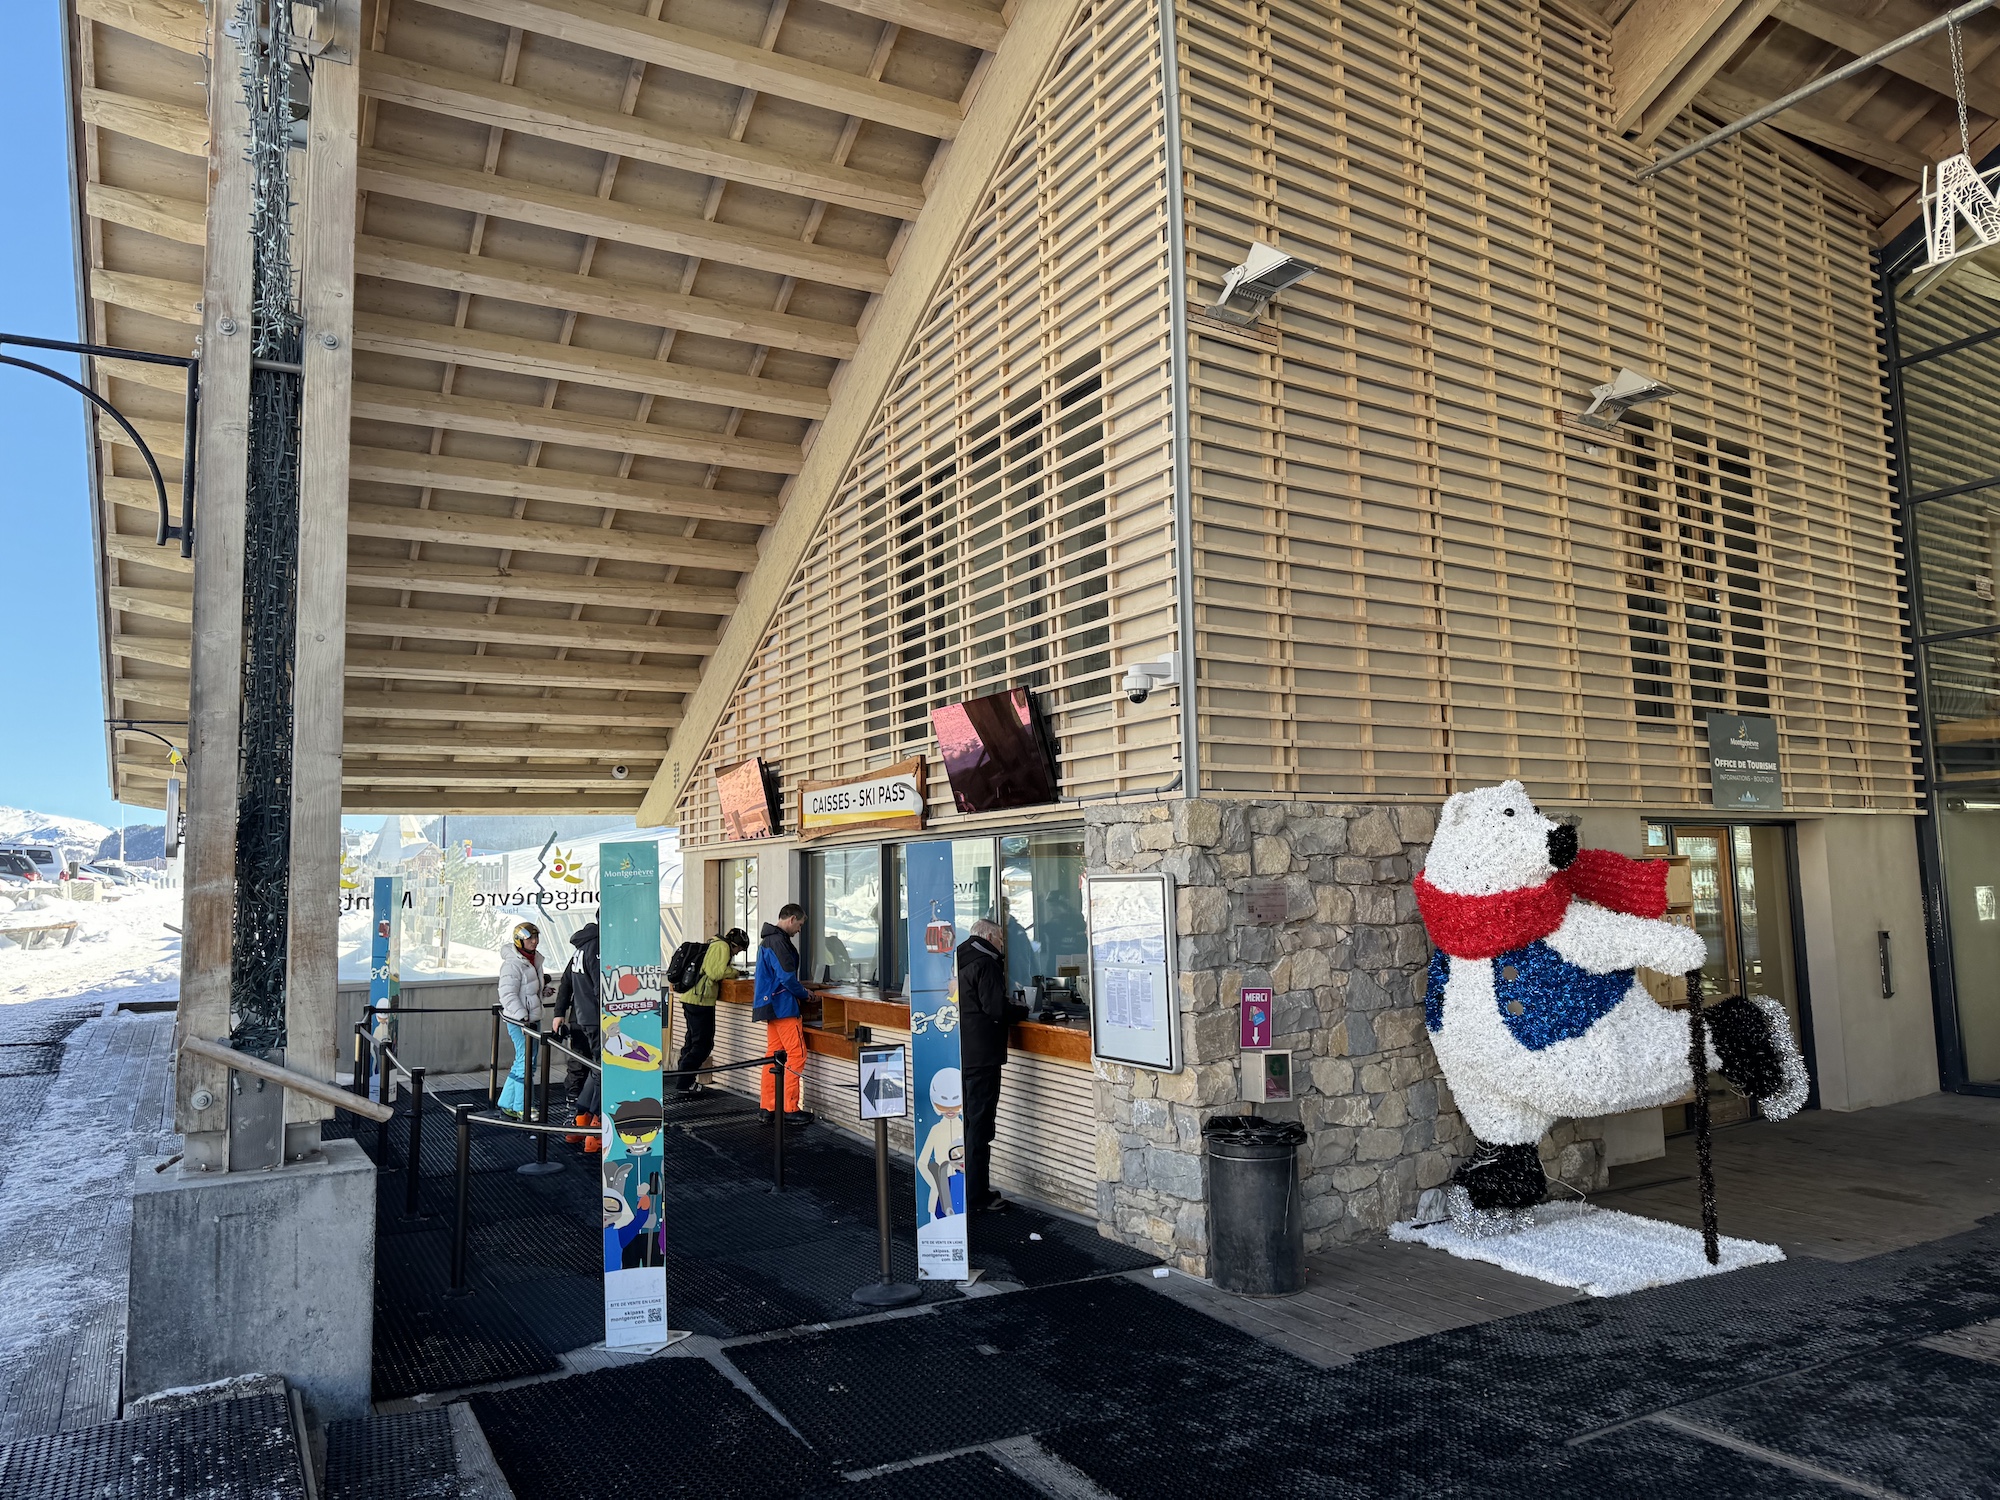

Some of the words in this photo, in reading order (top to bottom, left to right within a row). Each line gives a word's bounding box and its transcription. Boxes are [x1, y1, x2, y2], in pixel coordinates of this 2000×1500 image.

[1754, 775, 1774, 783] BOUTIQUE
[812, 792, 850, 814] CAISSES
[859, 788, 875, 806] SKI
[878, 783, 905, 804] PASS
[604, 869, 654, 878] Montgenèvre
[633, 966, 661, 974] LUGE
[1245, 993, 1268, 1002] MERCI
[609, 1002, 654, 1011] EXPRESS
